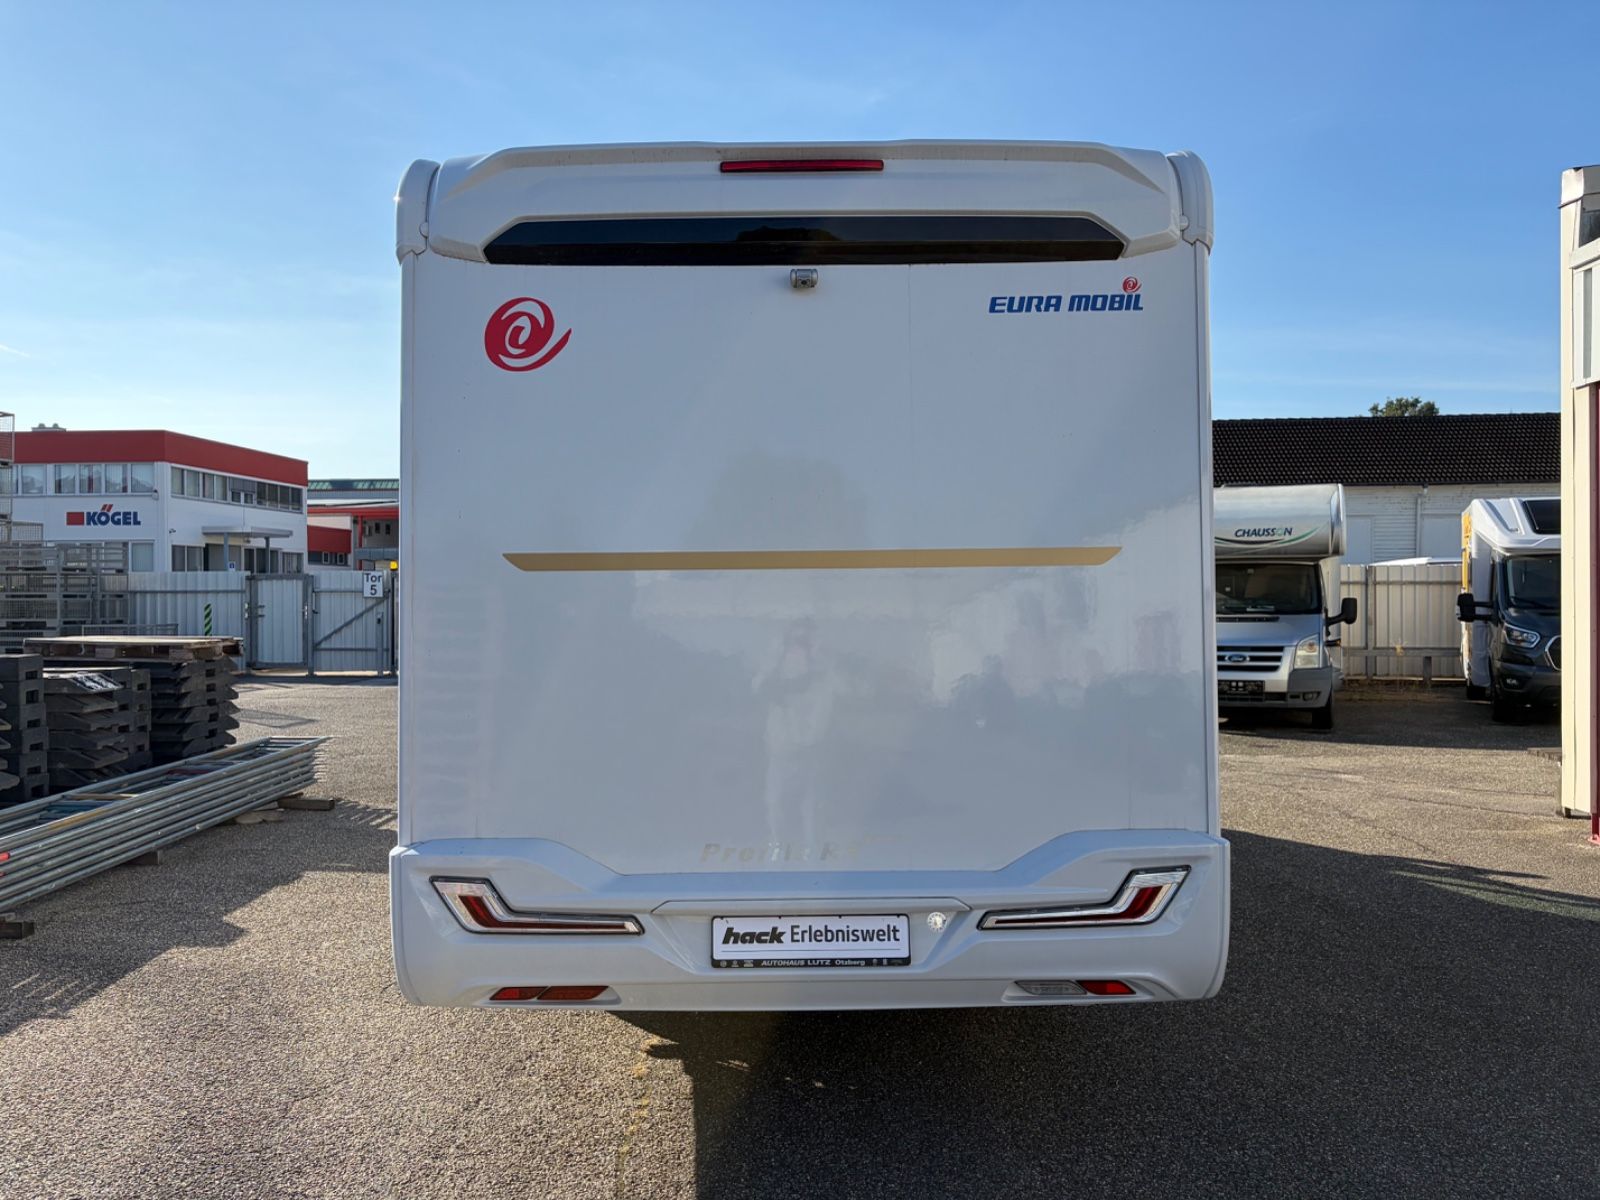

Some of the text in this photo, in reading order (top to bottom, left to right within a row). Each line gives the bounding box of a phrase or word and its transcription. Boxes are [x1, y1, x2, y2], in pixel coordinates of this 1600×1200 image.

[989, 294, 1143, 313] EURA MOBIL
[86, 503, 142, 526] KÖGEL
[1234, 527, 1293, 538] CHAUSSON
[363, 572, 382, 584] Tor
[369, 585, 377, 596] 5
[722, 924, 900, 945] hack Erlebniswelt
[834, 959, 866, 967] Otzberg
